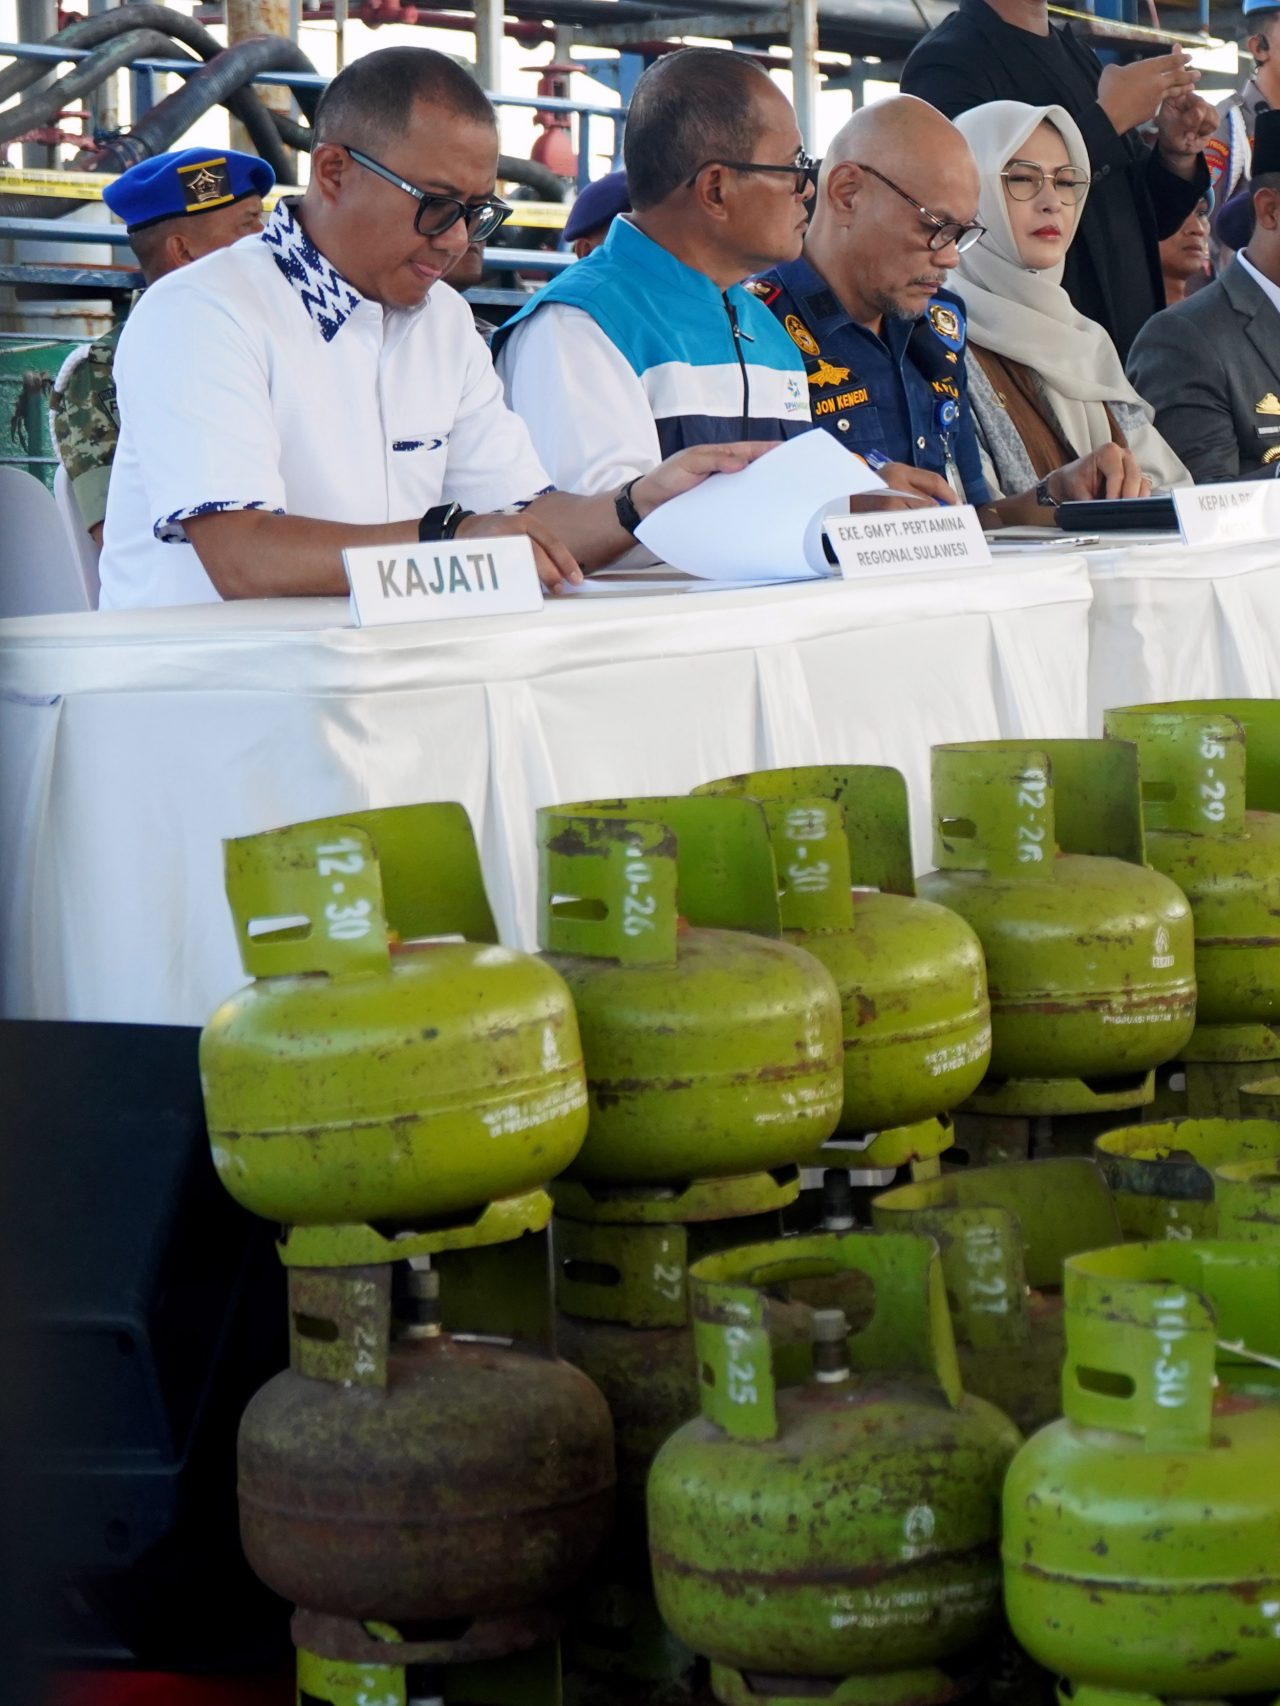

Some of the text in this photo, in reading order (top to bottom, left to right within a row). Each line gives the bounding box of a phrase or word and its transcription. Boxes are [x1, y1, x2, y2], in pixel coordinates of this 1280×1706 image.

[815, 388, 869, 416] JON KENEDI
[838, 525, 864, 542] EXE.
[866, 524, 883, 540] GM
[903, 516, 966, 536] PERTAMINA
[856, 541, 969, 567] REGIONAL SULAWESI
[377, 553, 500, 599] KAJATI
